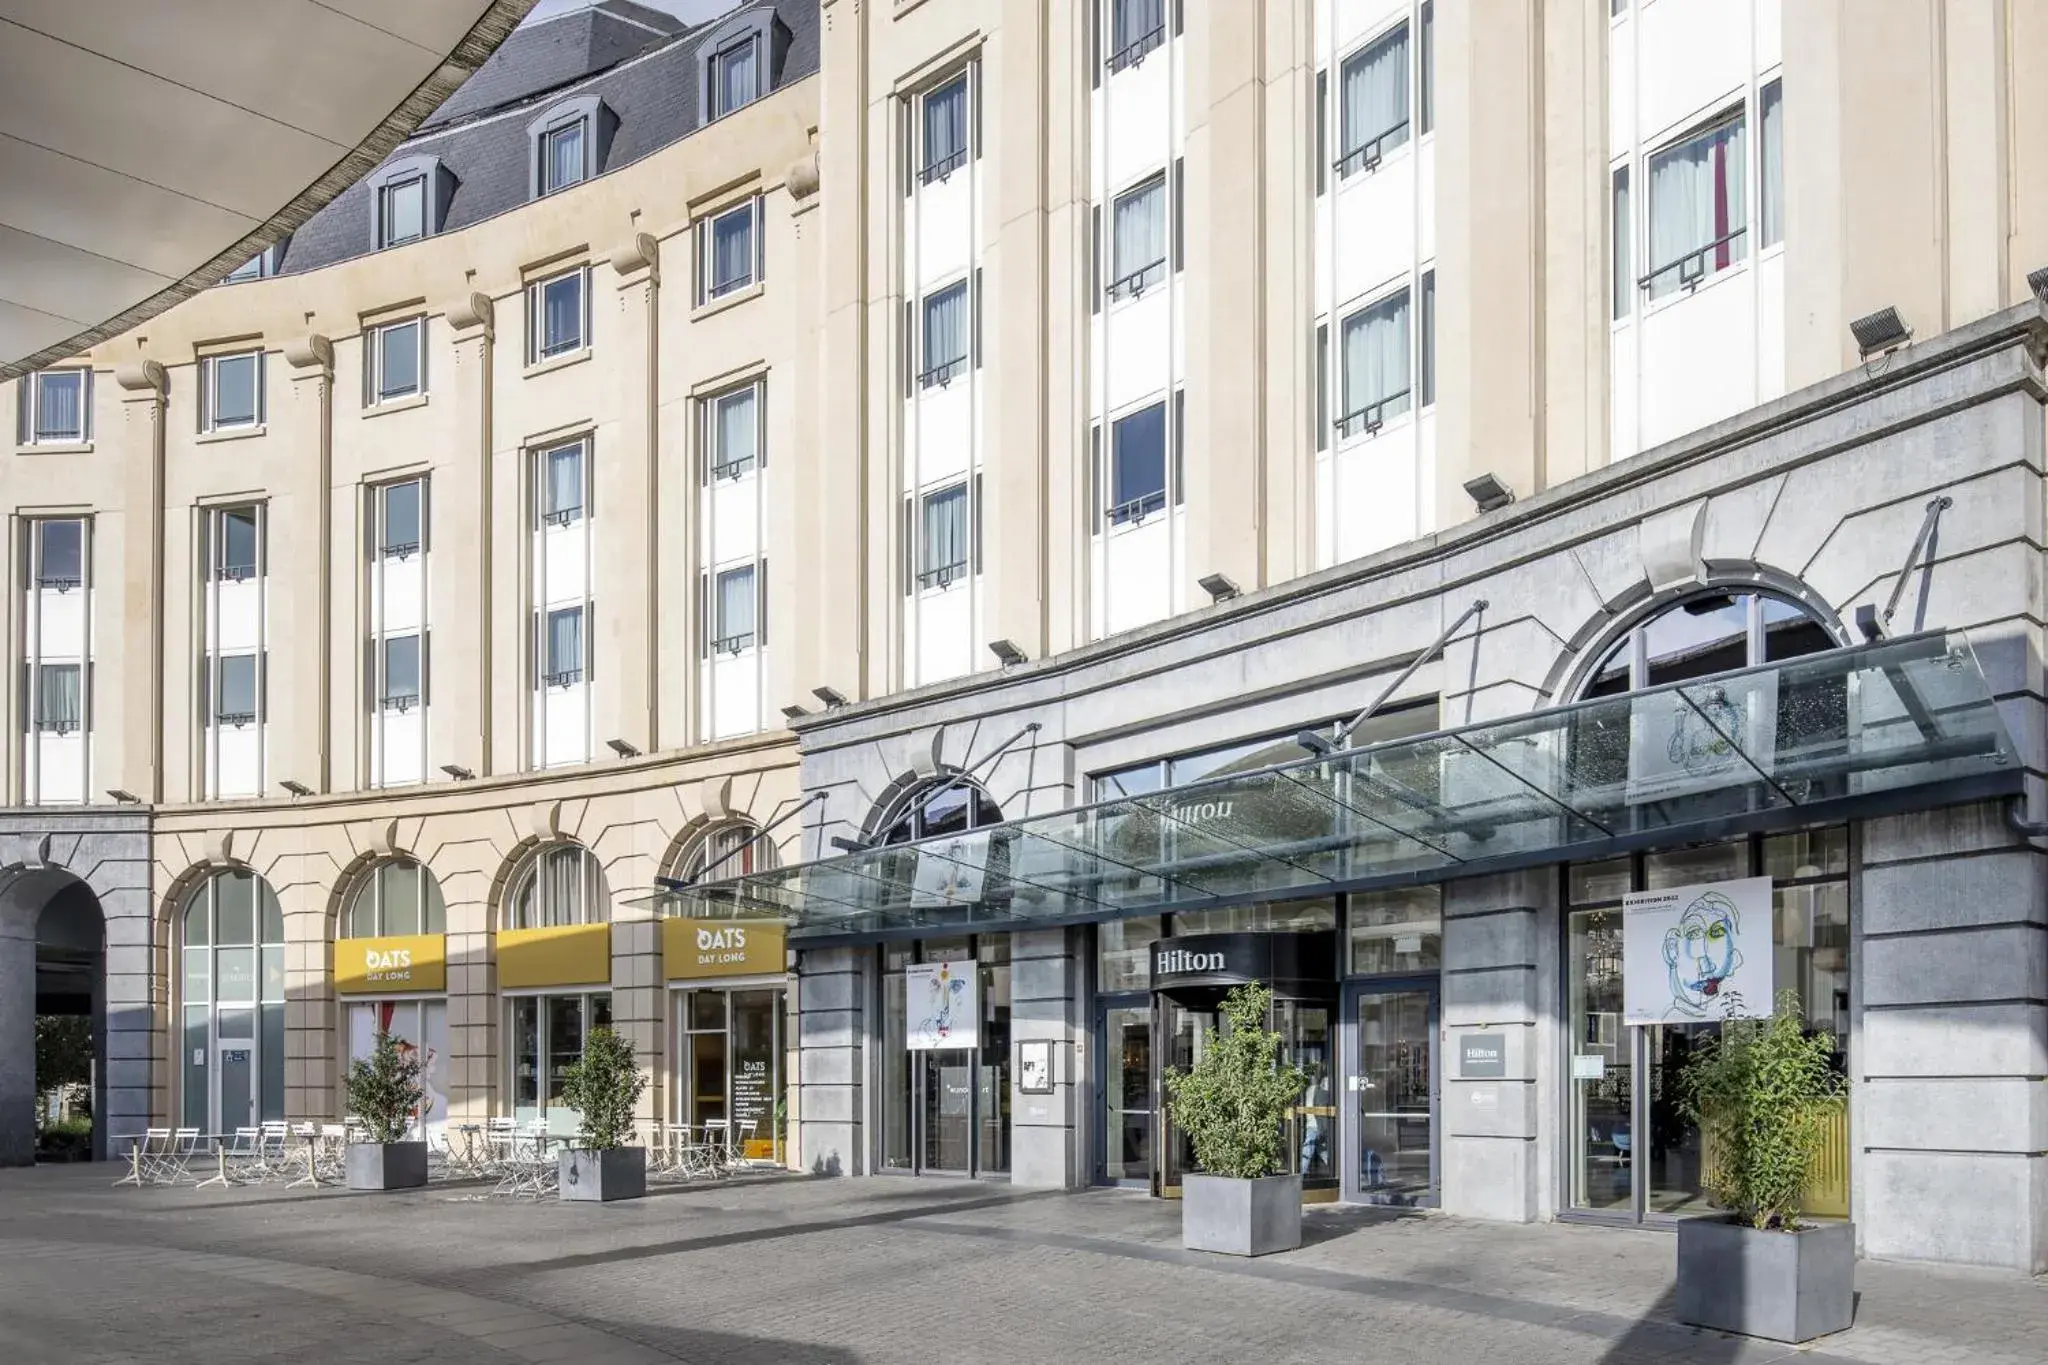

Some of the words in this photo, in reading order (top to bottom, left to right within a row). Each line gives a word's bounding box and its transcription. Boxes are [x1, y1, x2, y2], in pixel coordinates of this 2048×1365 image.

[697, 928, 746, 951] OATS
[366, 948, 411, 969] OATS
[698, 954, 716, 964] DAY
[719, 952, 745, 963] LONG
[1157, 949, 1227, 974] Hilton
[367, 972, 383, 981] DAY
[386, 971, 411, 981] LONG
[1467, 1048, 1498, 1058] Hilton
[743, 1060, 766, 1071] OATS
